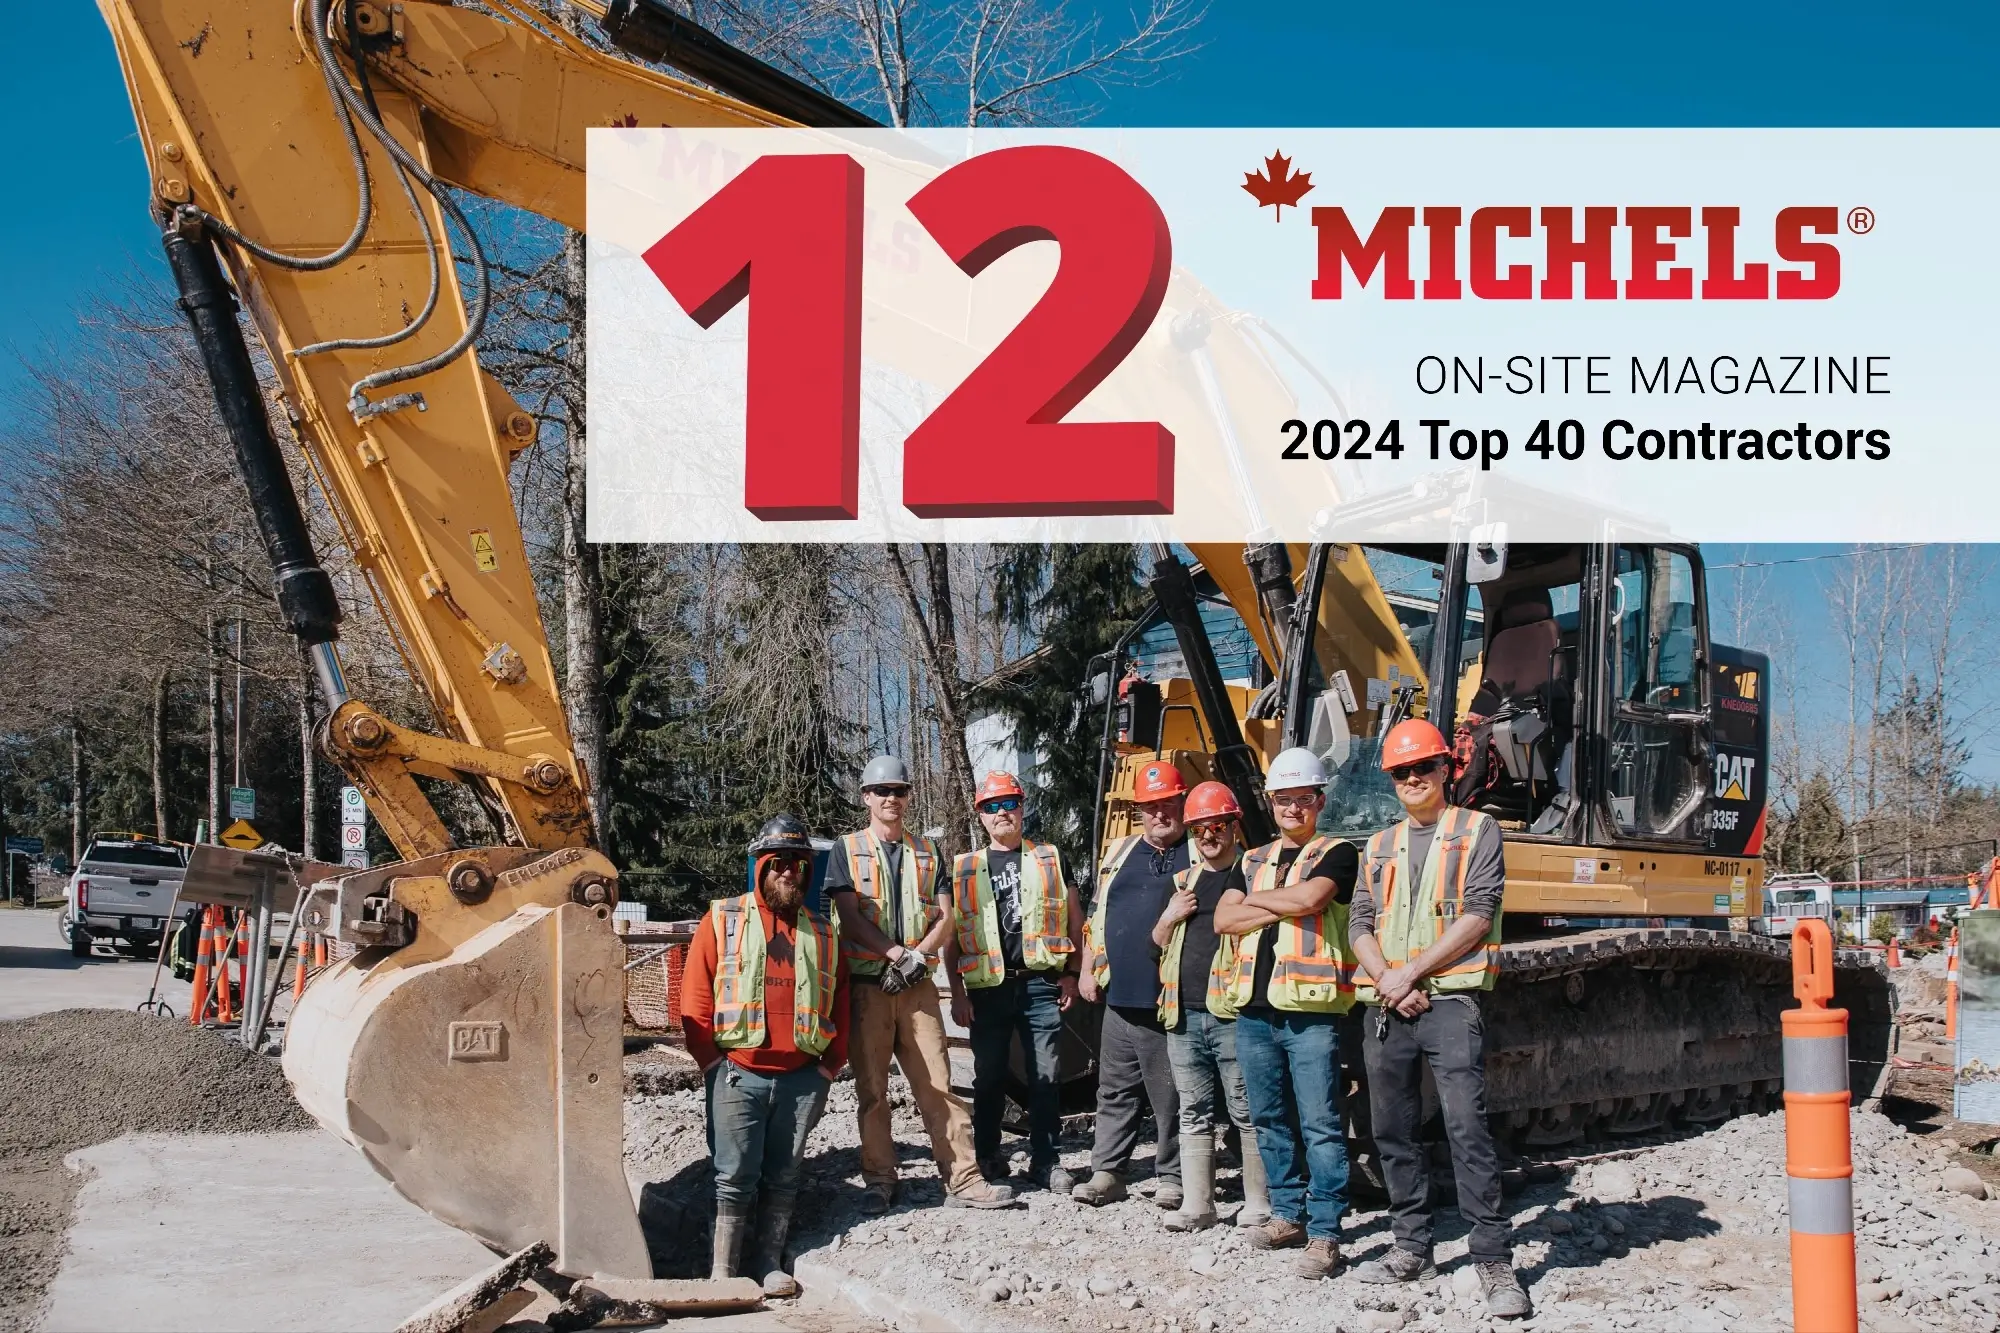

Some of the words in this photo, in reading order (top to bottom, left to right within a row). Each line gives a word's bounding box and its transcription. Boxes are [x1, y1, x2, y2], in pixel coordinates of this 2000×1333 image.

[1715, 753, 1754, 800] CAT
[1712, 809, 1739, 831] 335F
[1704, 860, 1740, 876] NC-0117
[454, 1027, 501, 1053] CAT
